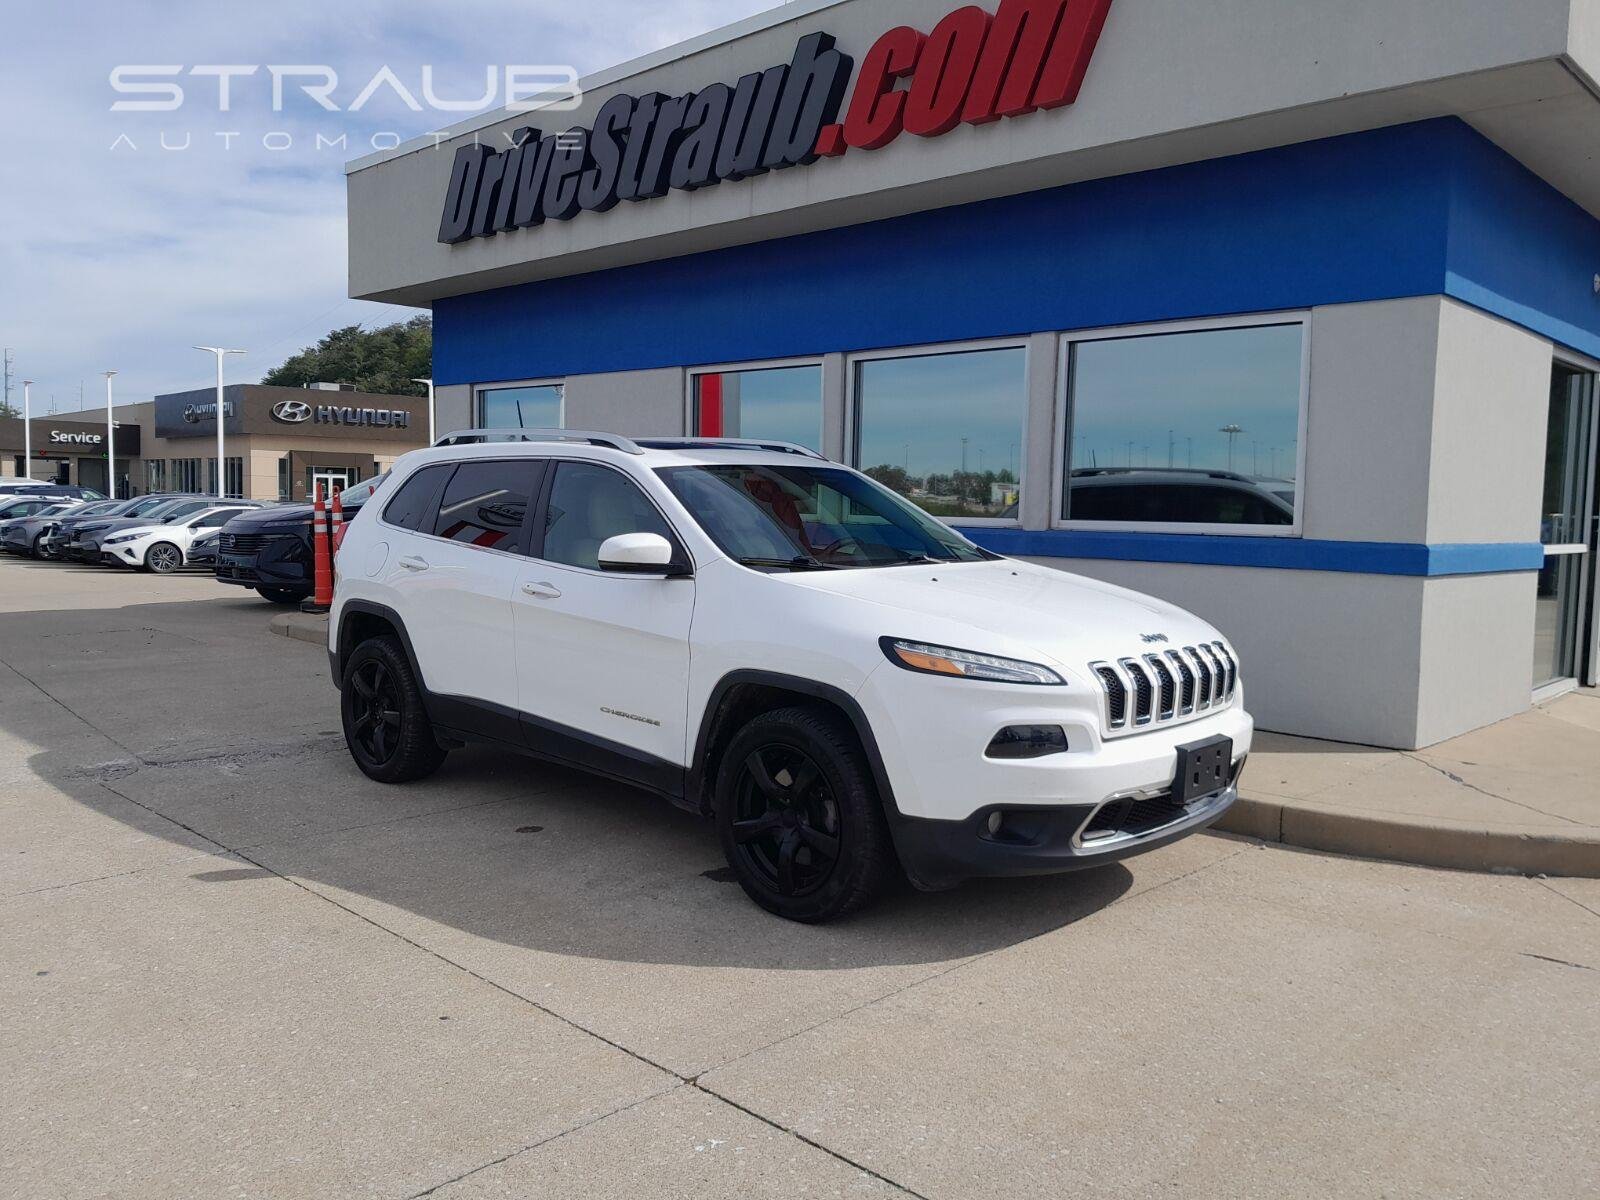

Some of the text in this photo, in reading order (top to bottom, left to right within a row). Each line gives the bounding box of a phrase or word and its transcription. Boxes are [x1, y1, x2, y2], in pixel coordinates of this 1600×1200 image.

[439, 0, 1112, 243] DriveStraub.com
[316, 405, 411, 427] HYUNDAI
[50, 430, 101, 444] Service
